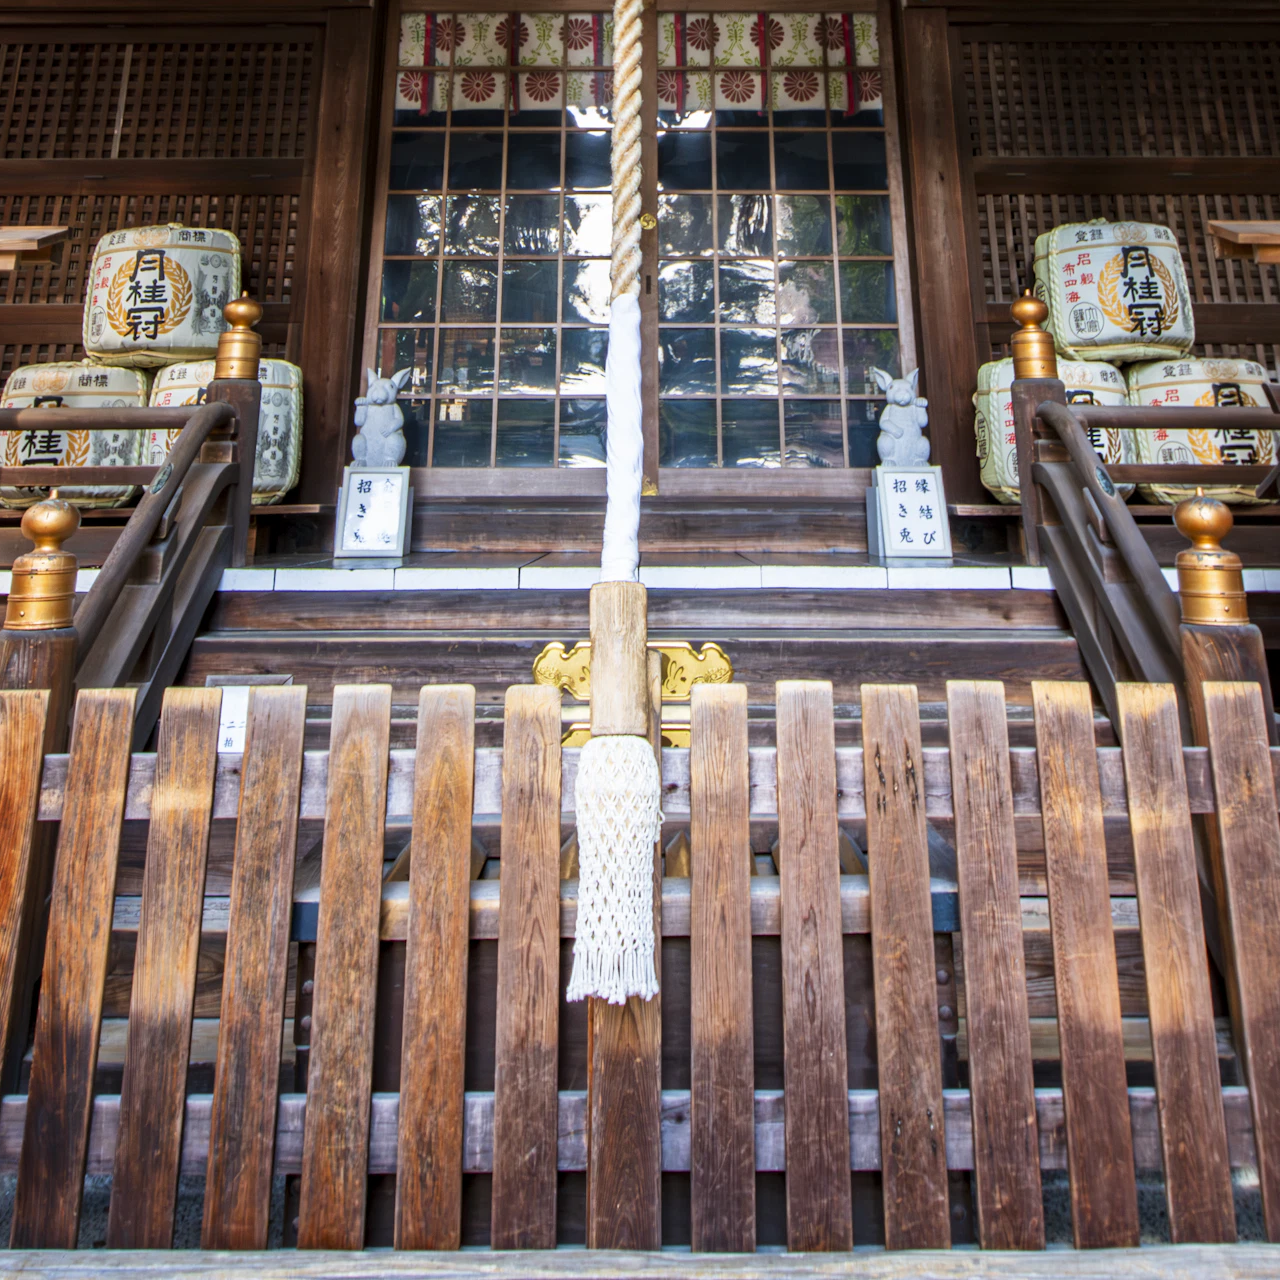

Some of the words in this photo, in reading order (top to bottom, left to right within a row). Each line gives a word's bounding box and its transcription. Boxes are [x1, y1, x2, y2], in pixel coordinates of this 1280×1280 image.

[179, 230, 207, 243] 商標
[123, 248, 168, 342] 月桂冠
[1120, 246, 1165, 337] 月桂冠
[78, 374, 109, 387] 商標
[914, 478, 937, 545] 縁結び
